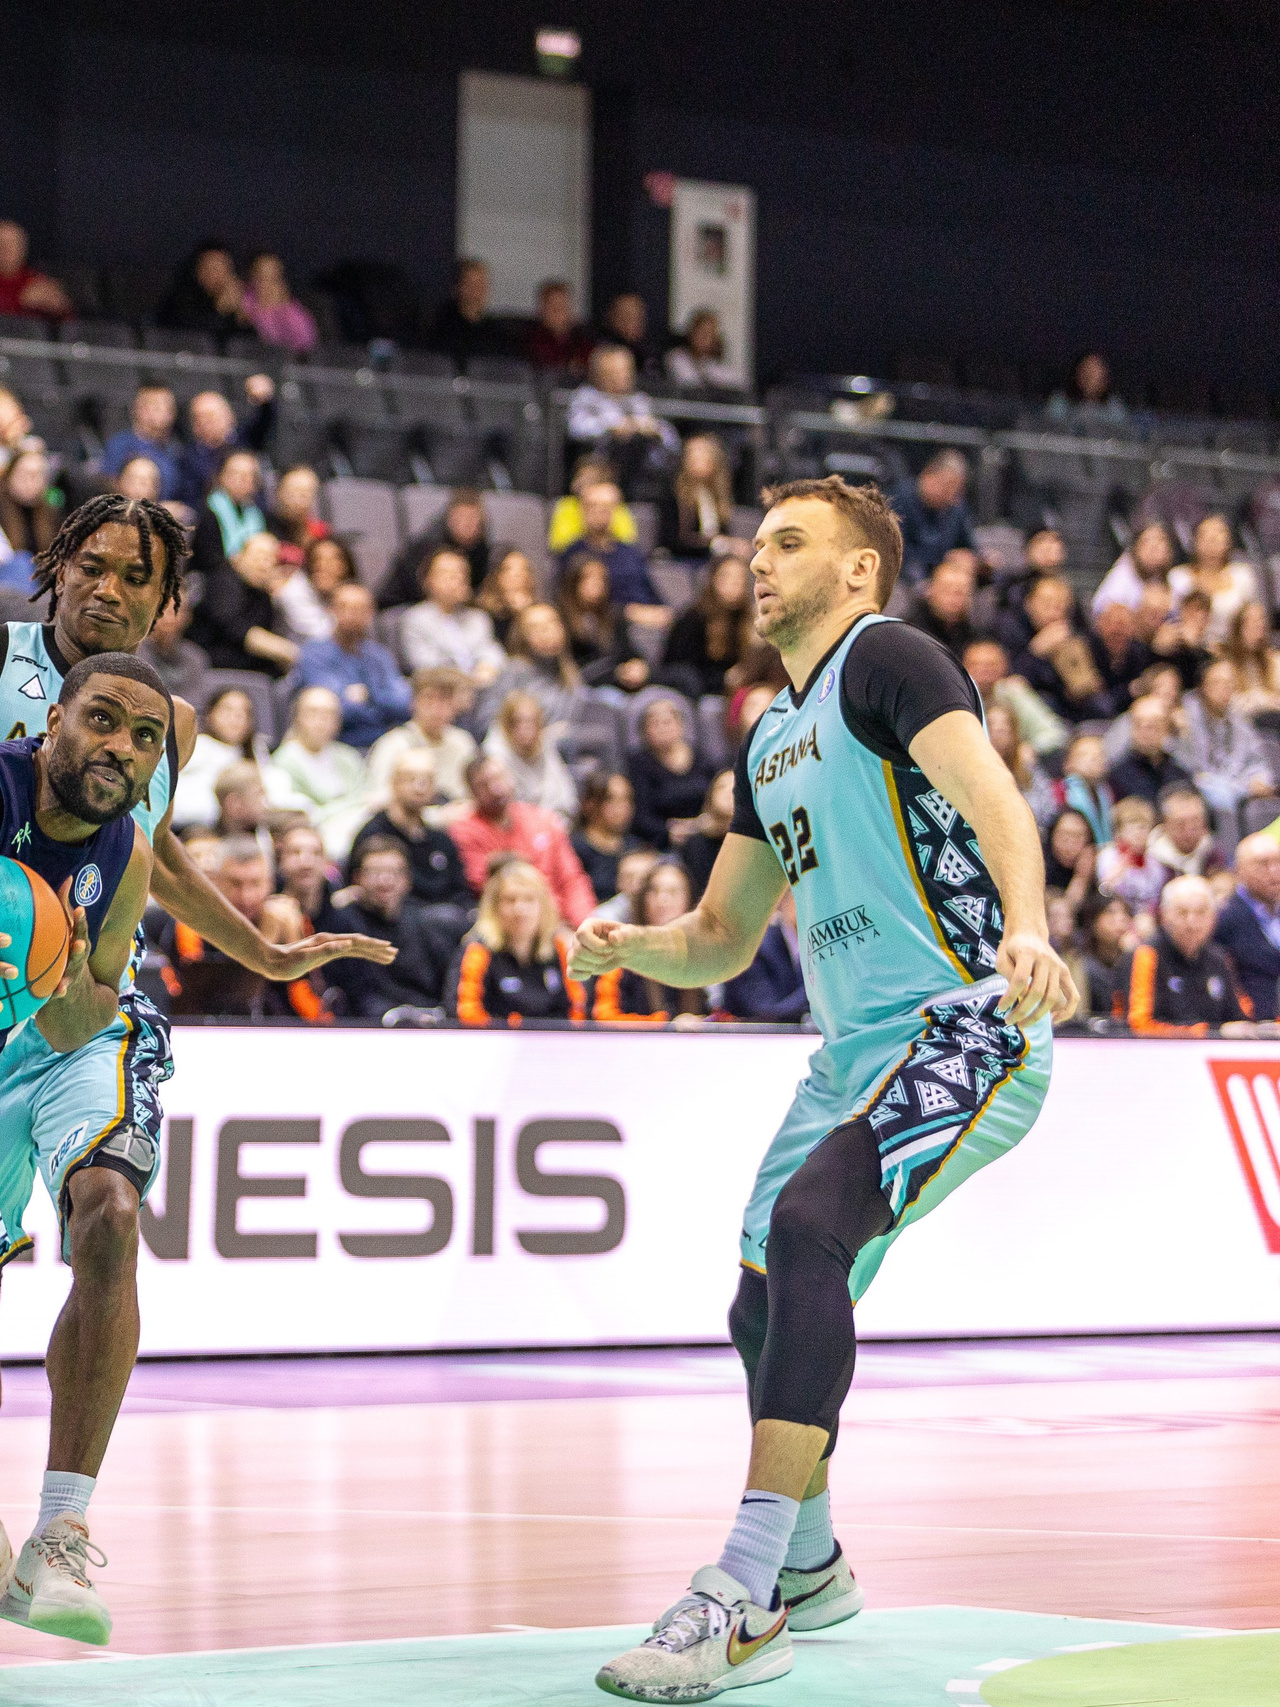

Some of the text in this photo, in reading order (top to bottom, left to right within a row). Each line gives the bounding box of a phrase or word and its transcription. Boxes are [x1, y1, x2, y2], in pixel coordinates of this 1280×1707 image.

[754, 721, 823, 795] ASTANA
[769, 805, 820, 887] 22
[808, 907, 874, 951] AMRUK
[811, 928, 881, 966] AZYNA
[10, 1115, 628, 1263] NESIS
